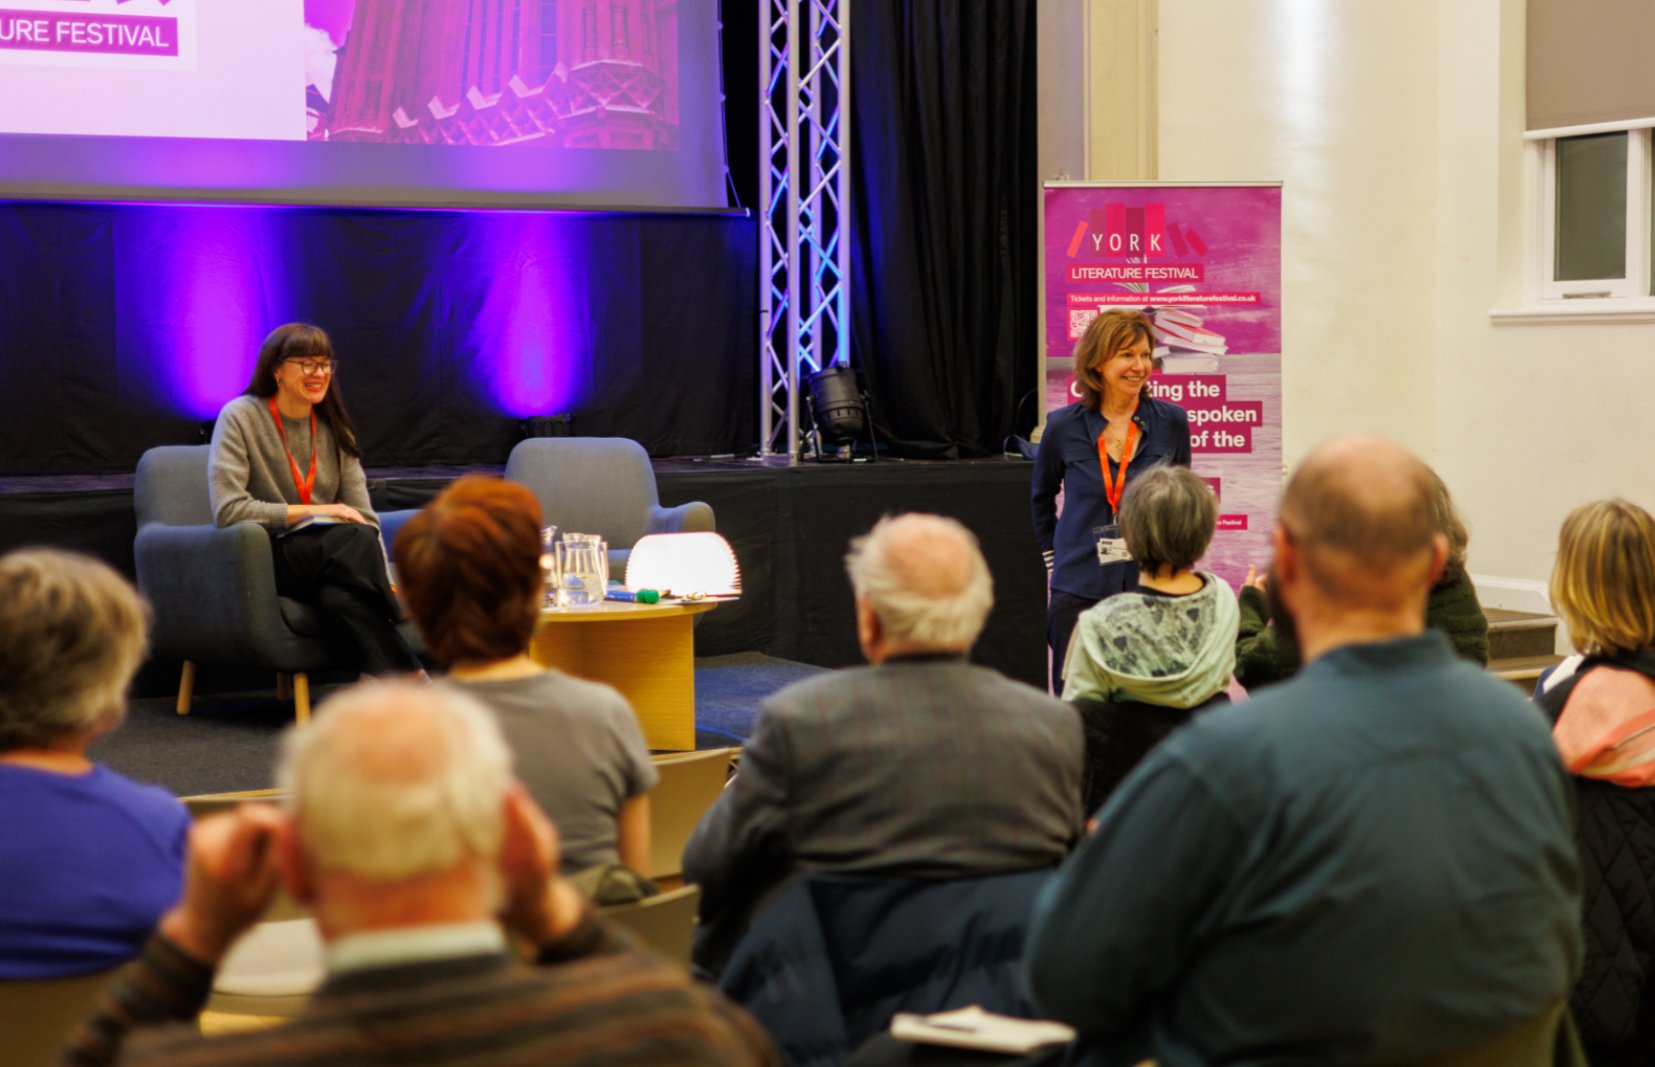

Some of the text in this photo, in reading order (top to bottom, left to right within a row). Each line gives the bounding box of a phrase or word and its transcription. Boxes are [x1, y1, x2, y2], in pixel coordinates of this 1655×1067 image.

[56, 21, 170, 47] FESTIVAL
[1092, 233, 1162, 251] YORK
[1071, 267, 1199, 279] LITERATURE FESTIVAL
[1071, 295, 1092, 303] Tickets
[1093, 295, 1105, 303] and
[1107, 295, 1141, 303] information
[1187, 380, 1221, 398] the
[1187, 405, 1257, 426] spoken
[1190, 430, 1245, 447] of the
